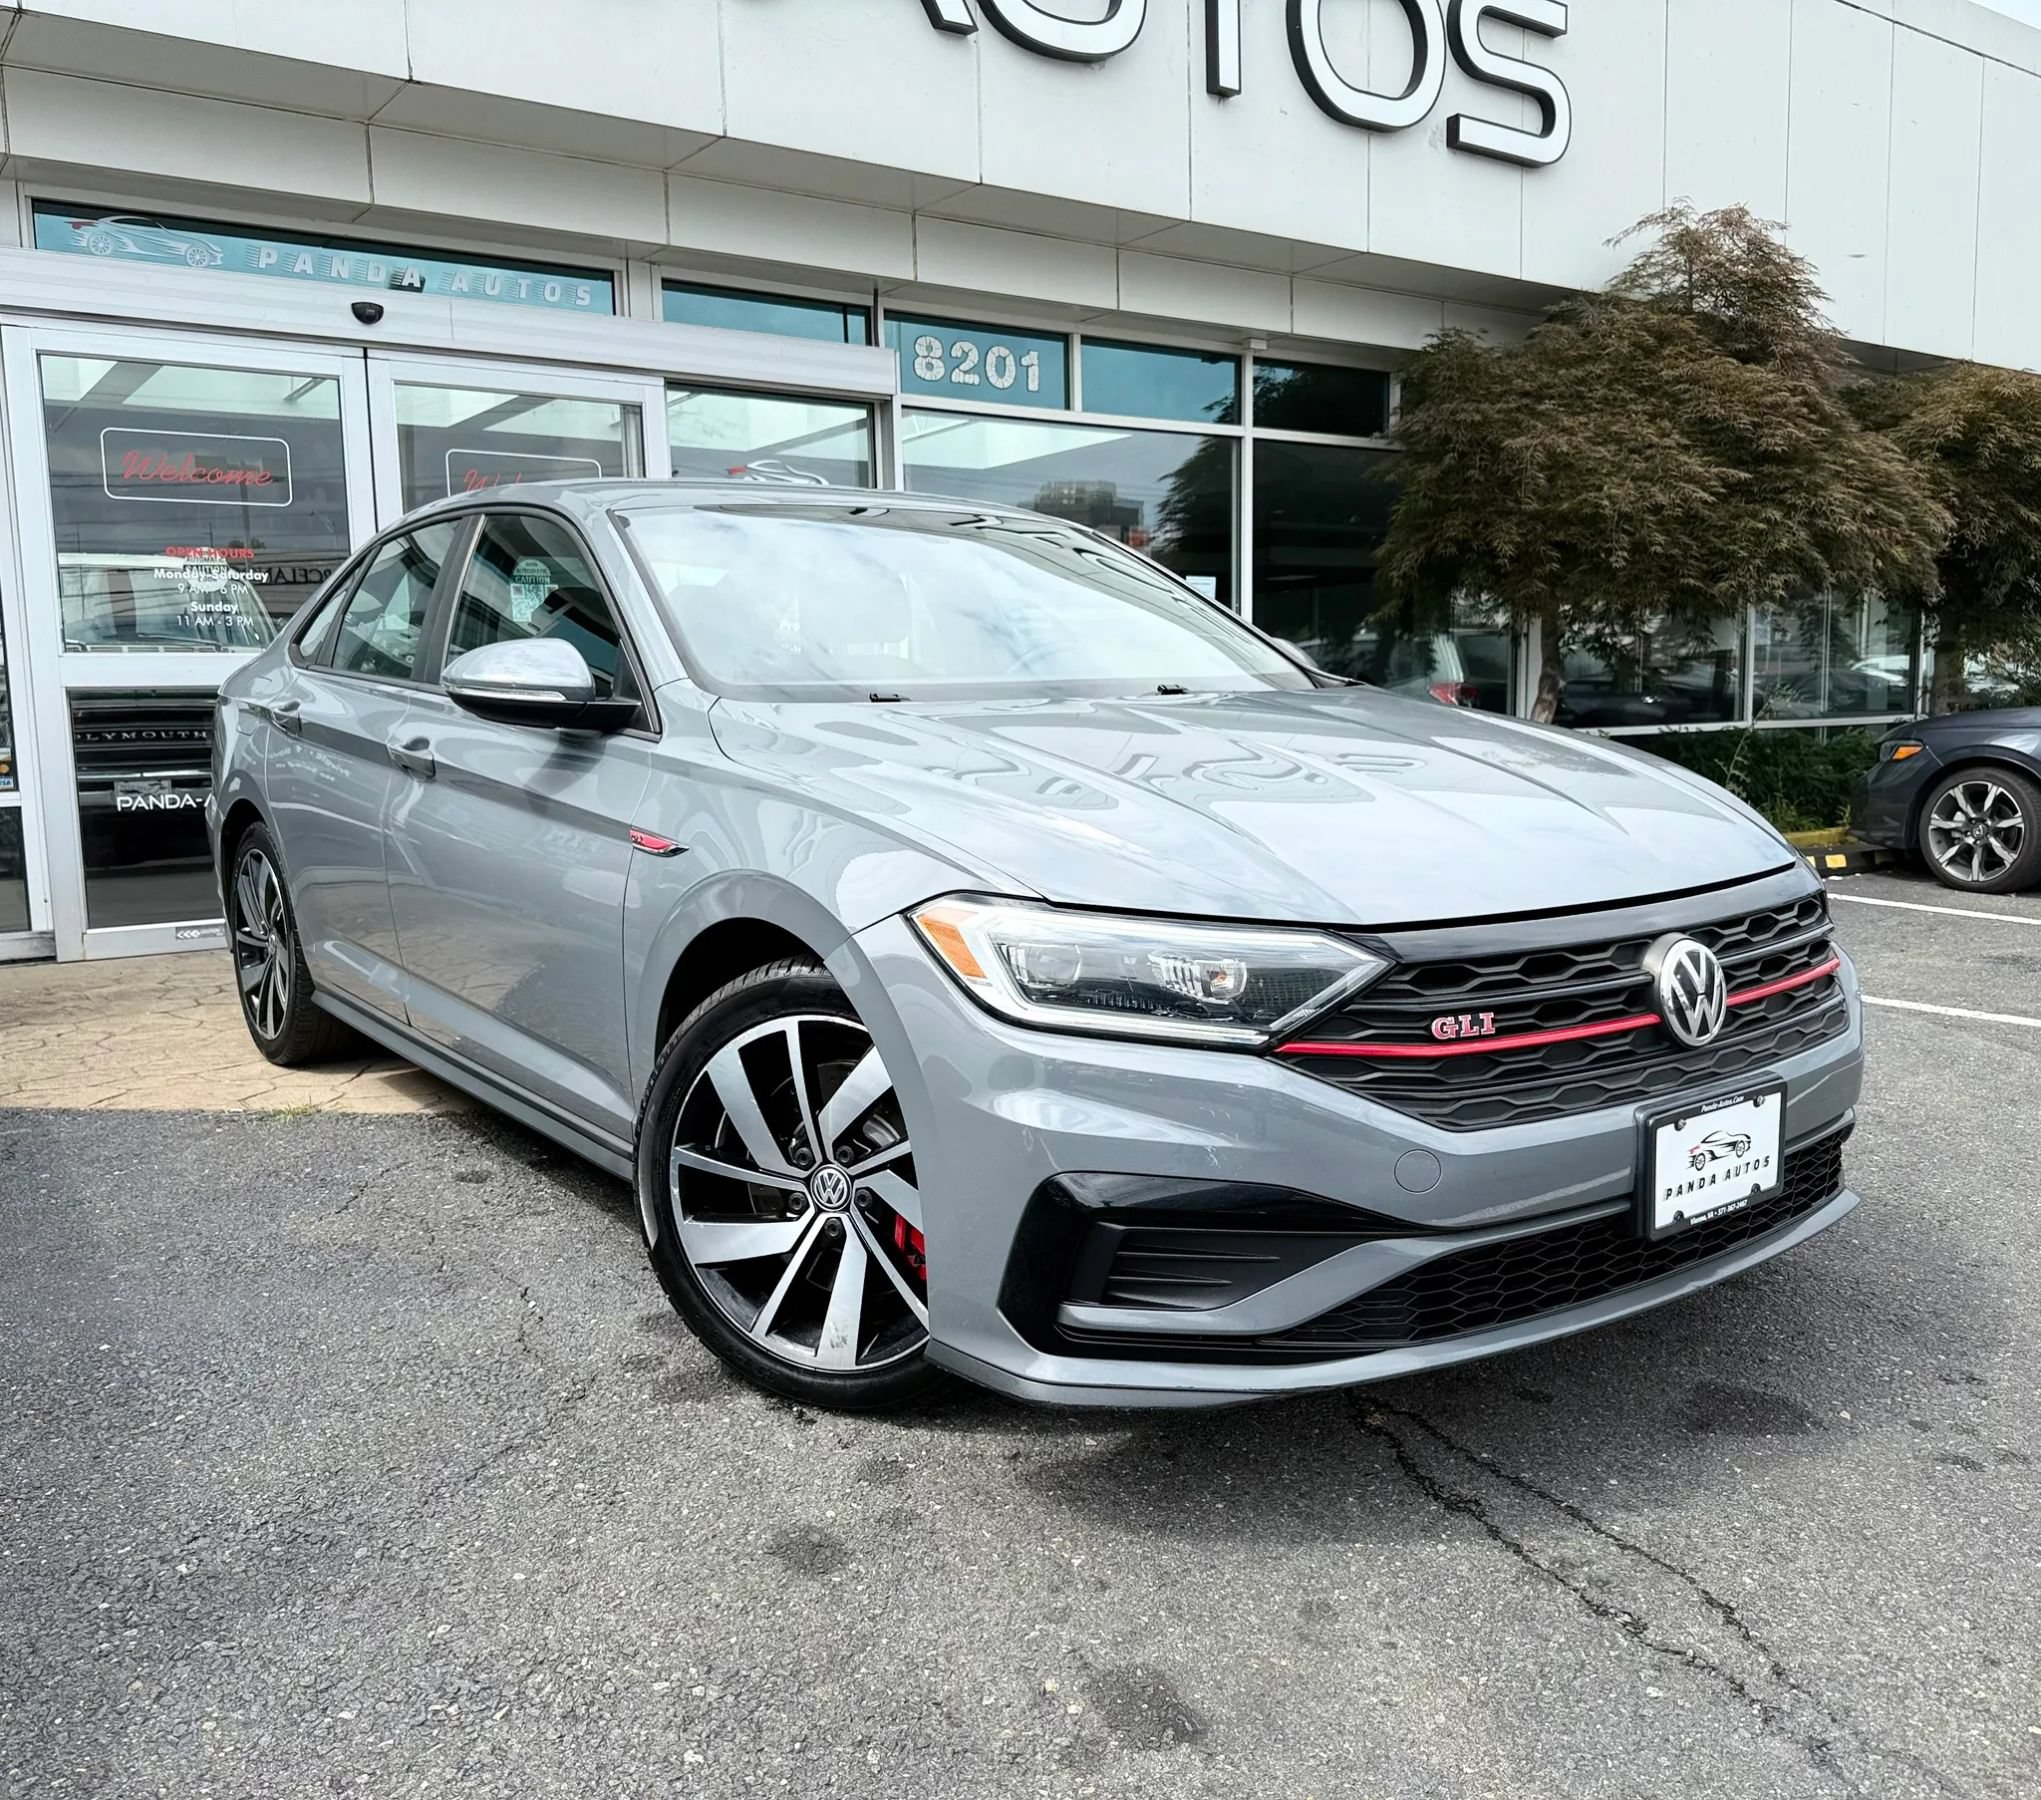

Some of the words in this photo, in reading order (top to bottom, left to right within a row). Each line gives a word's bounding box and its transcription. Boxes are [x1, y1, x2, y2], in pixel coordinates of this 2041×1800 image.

[250, 244, 421, 289] PANDA
[446, 269, 591, 307] AUTOS
[913, 334, 1039, 392] 8201
[122, 449, 273, 486] Welcome
[165, 546, 202, 558] OPEN
[206, 547, 255, 560] HOURS
[153, 568, 269, 584] Monday-Saturday
[177, 584, 185, 595] 9
[190, 584, 209, 595] AM
[219, 584, 228, 595] 6
[230, 584, 249, 595] PM
[190, 601, 239, 615] Sunday
[176, 616, 190, 627] 11
[194, 616, 214, 627] AM
[226, 617, 233, 627] 3
[236, 617, 255, 627] PM
[1431, 1012, 1496, 1040] GLI
[1663, 1173, 1717, 1201] PANDA
[1723, 1155, 1771, 1181] AUTOS
